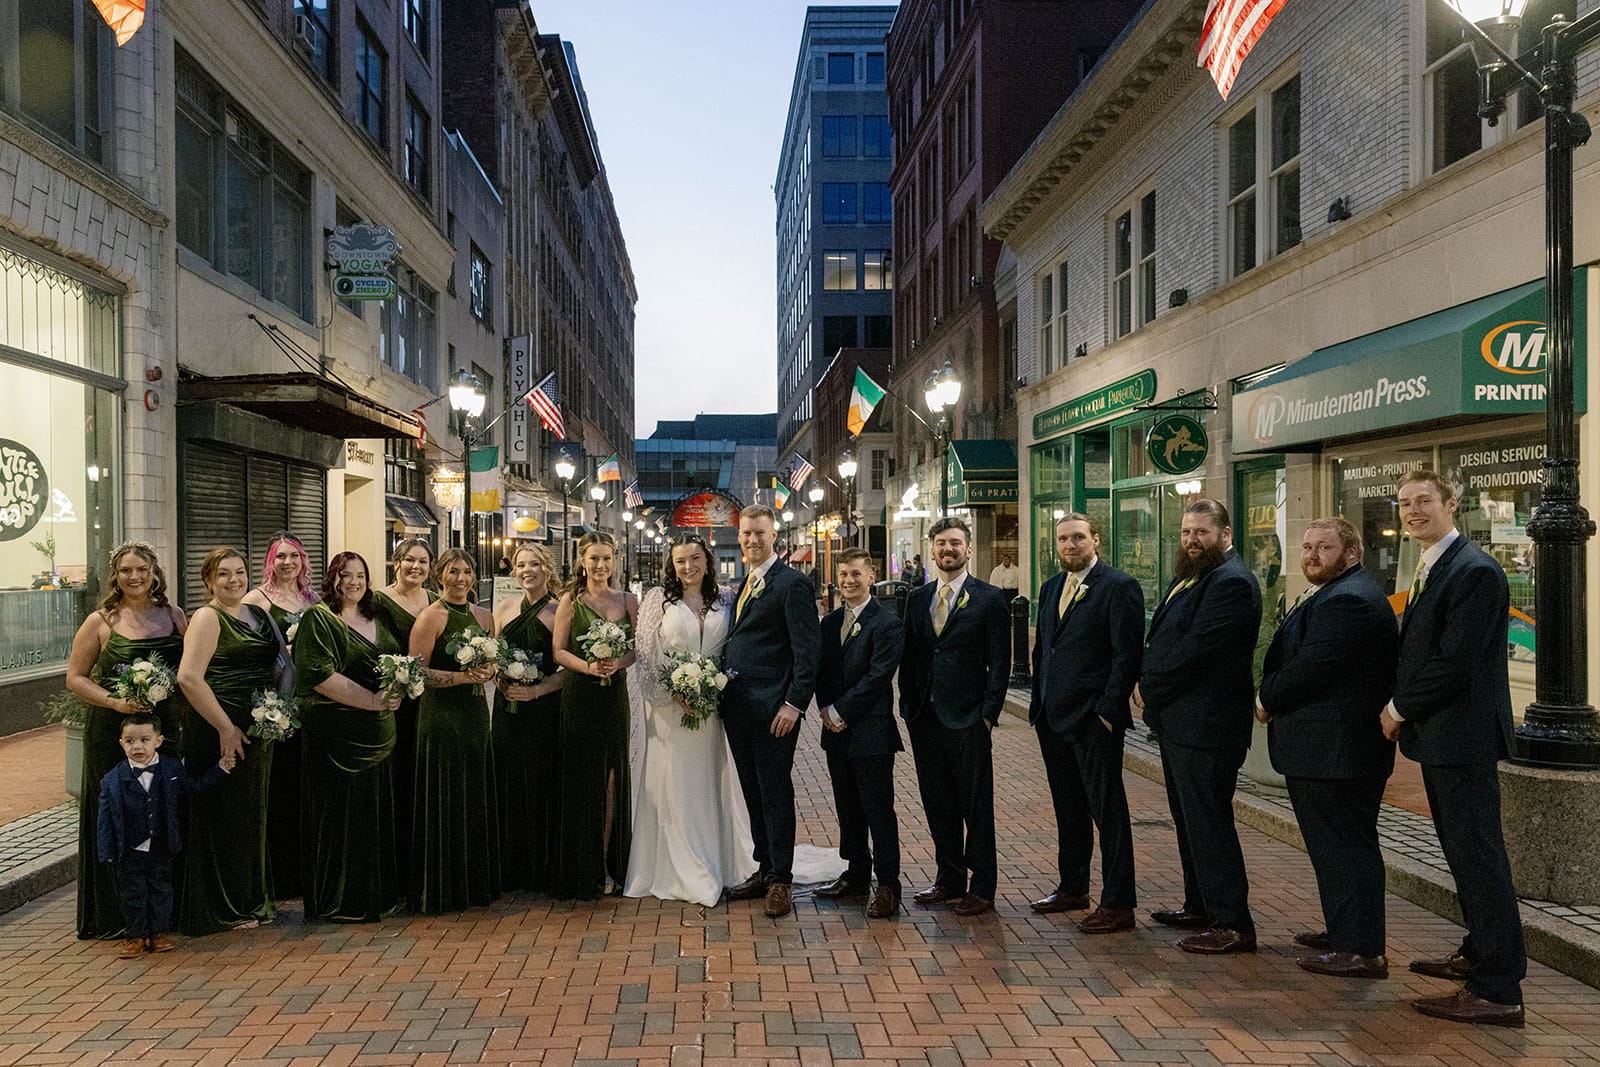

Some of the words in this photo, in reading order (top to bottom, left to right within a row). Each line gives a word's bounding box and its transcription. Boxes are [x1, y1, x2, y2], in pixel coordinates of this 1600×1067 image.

[334, 251, 388, 259] DOWNTOWN
[340, 259, 382, 271] YOGA
[355, 279, 387, 287] CYCLED
[513, 349, 525, 453] PSYCHIC
[1285, 387, 1374, 426] Minuteman
[1459, 451, 1499, 468] DESIGN
[1343, 465, 1377, 480] MAILING
[1382, 460, 1423, 476] PRINTING
[1469, 469, 1545, 489] PROMOTIONS
